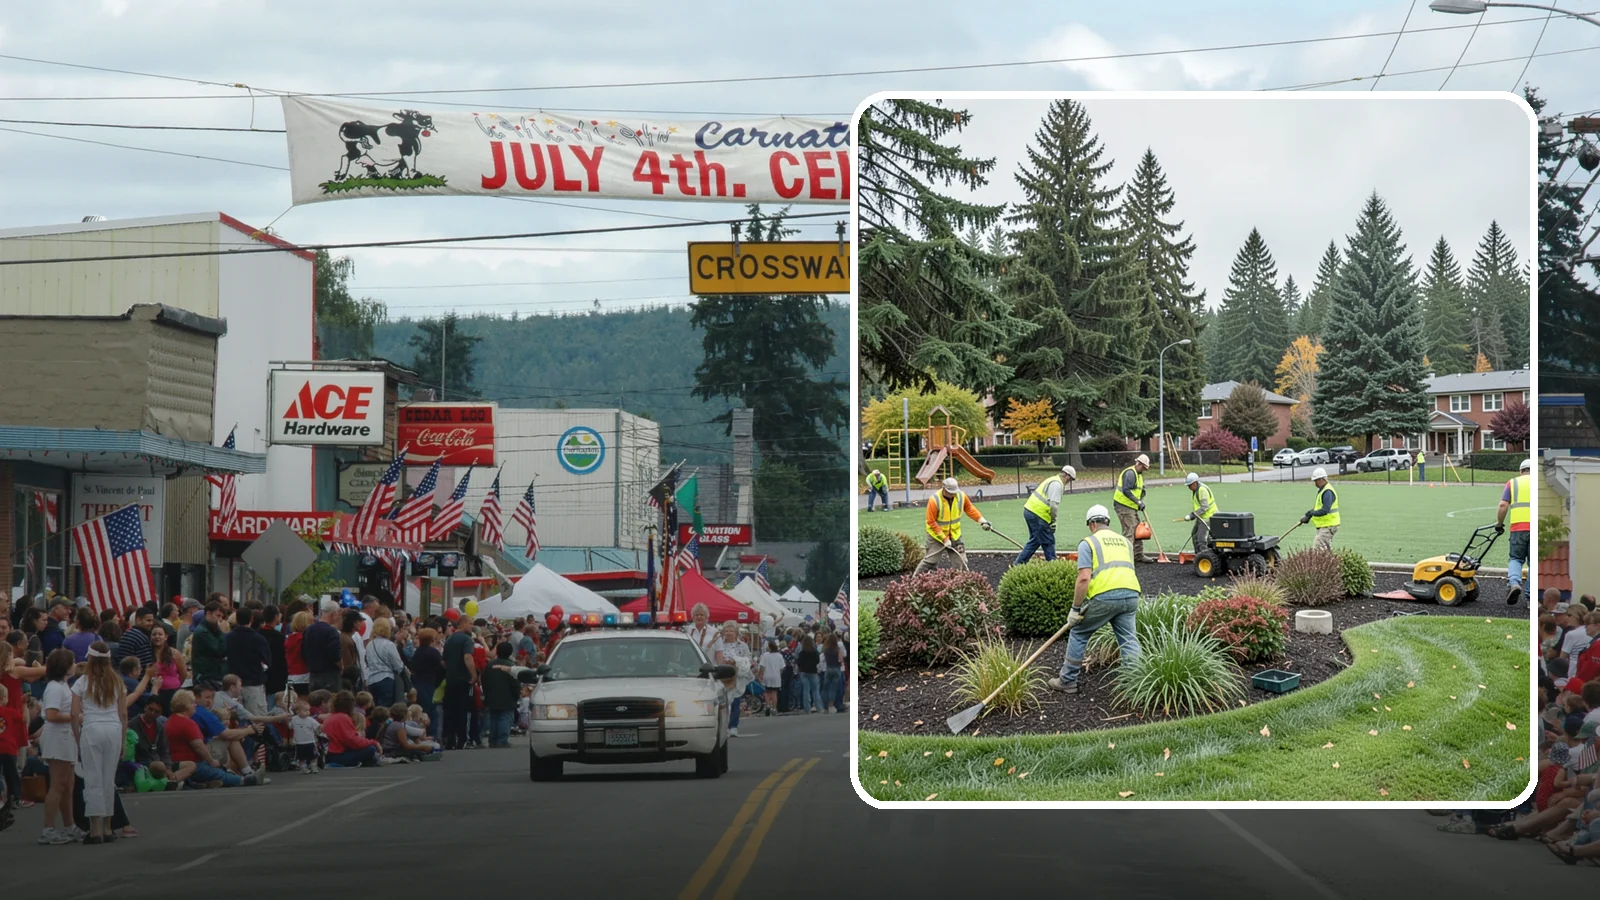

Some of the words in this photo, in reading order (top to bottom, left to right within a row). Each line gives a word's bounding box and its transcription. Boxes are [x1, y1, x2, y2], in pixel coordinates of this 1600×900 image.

[481, 141, 605, 192] JULY
[632, 150, 746, 198] 4th.
[697, 254, 850, 280] CROSSWA
[283, 380, 373, 420] ACE
[405, 409, 453, 422] CEDAR
[284, 421, 371, 437] Hardware
[83, 485, 93, 495] St.
[95, 485, 124, 495] Vincent
[126, 486, 136, 495] de
[137, 485, 155, 496] Paul
[688, 526, 742, 536] CRNATION
[699, 535, 730, 543] GLASS
